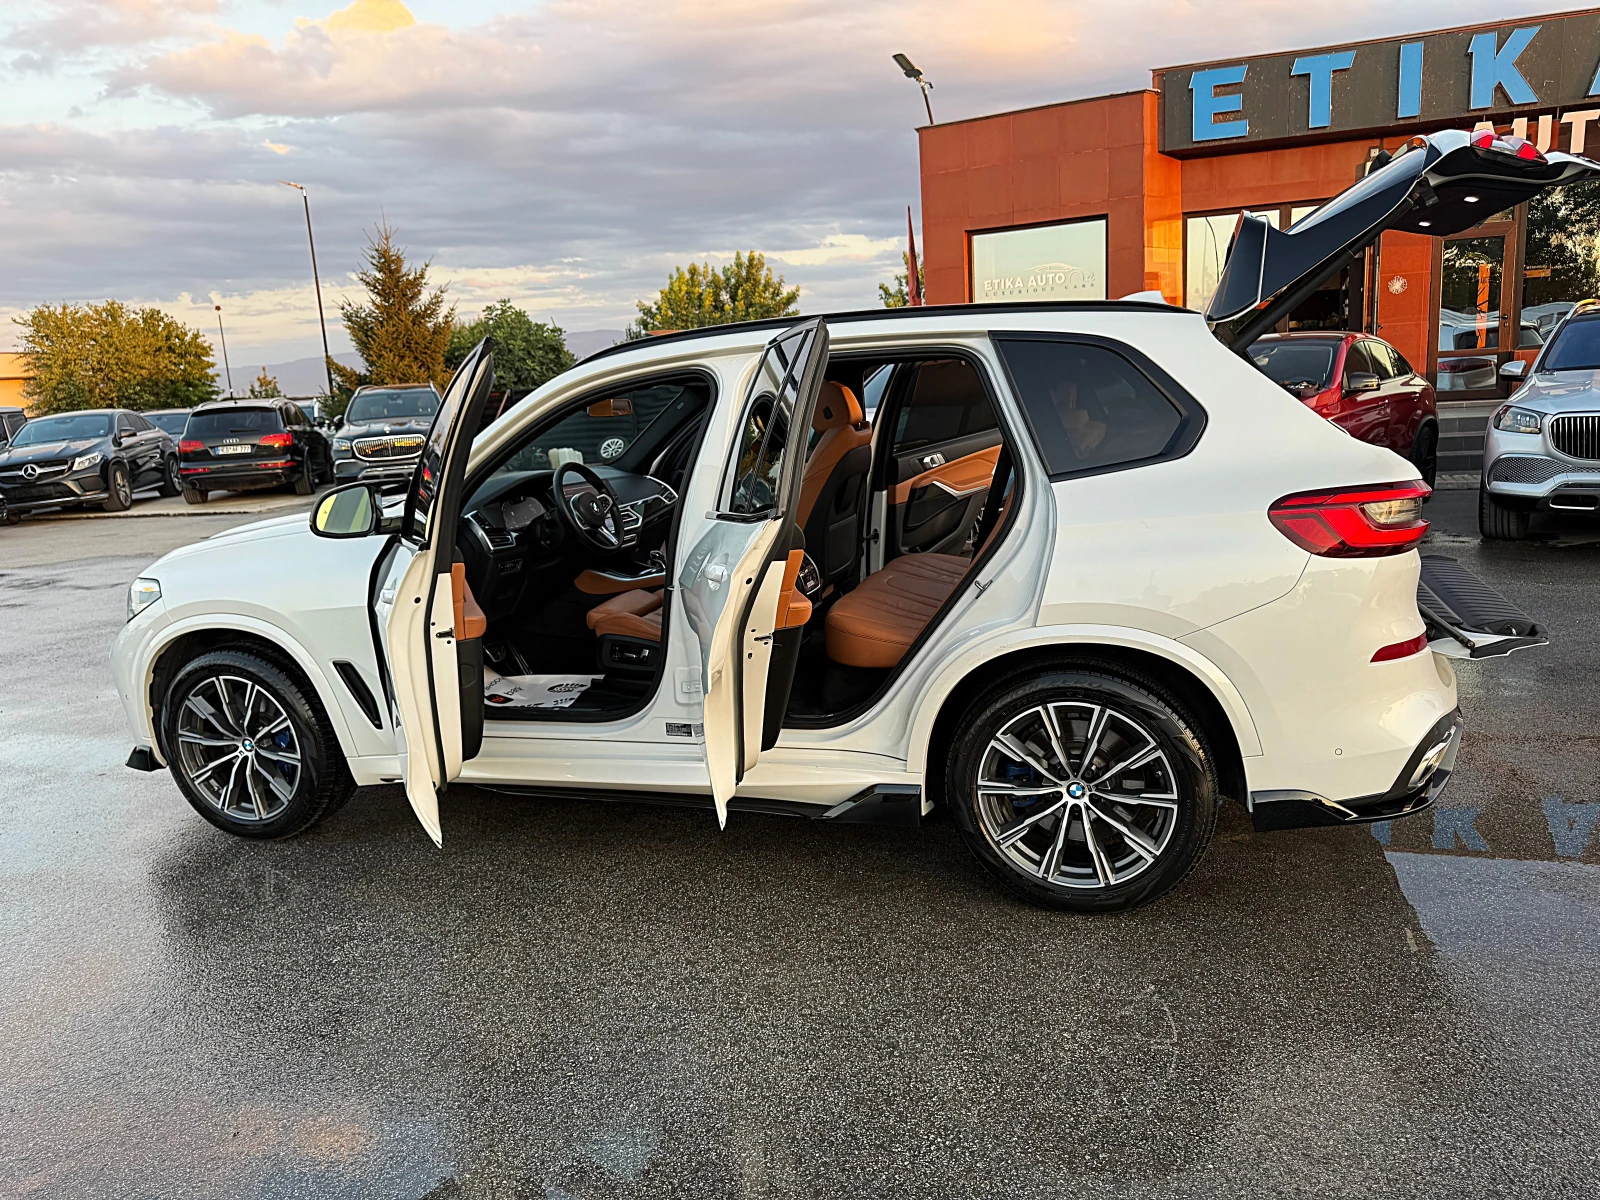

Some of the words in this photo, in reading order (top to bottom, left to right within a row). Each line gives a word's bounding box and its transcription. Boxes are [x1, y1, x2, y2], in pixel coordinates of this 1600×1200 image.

[1189, 24, 1600, 142] ETIK
[984, 276, 1023, 291] ETIKA
[1028, 273, 1066, 287] AUTO
[985, 287, 1055, 297] LUXURIOUS
